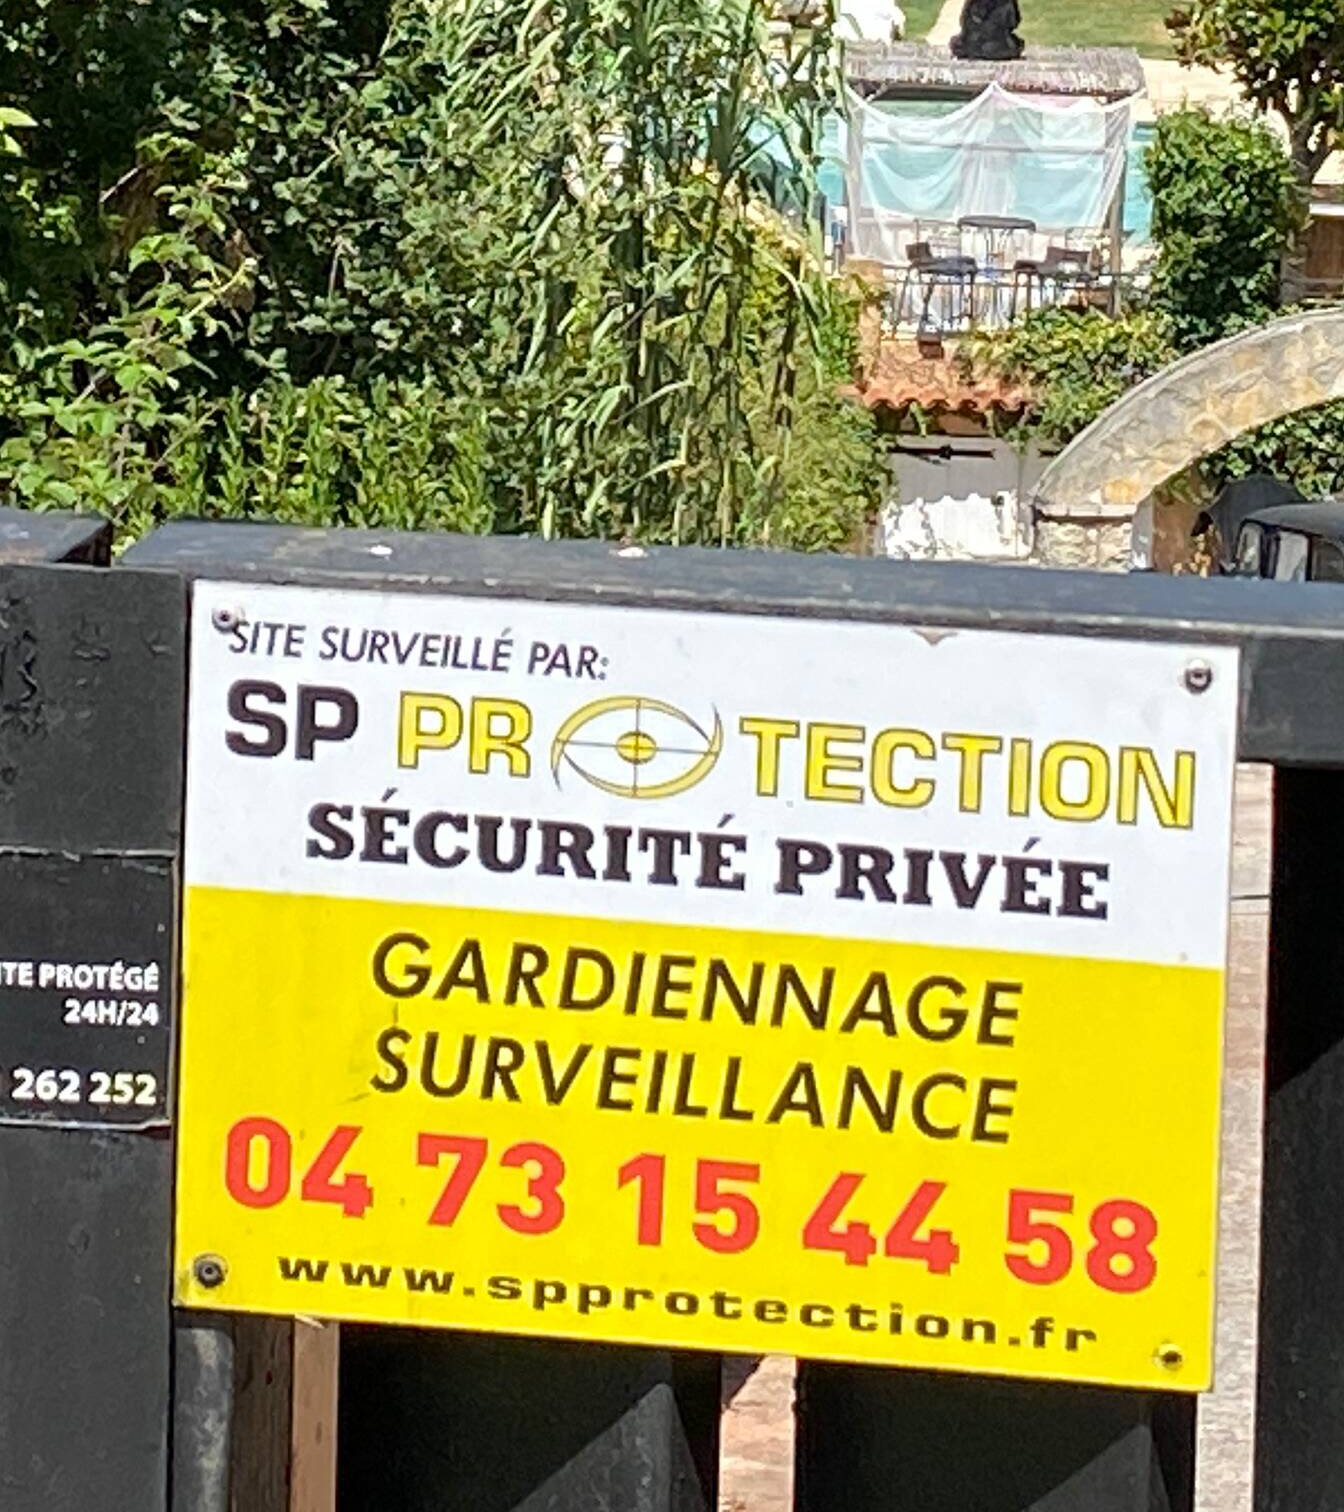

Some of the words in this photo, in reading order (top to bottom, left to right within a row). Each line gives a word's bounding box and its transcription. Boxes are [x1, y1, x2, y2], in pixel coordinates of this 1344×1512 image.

[229, 619, 307, 658] SITE
[319, 627, 514, 674] SURVEILLÉ
[527, 640, 610, 681] PAR:
[224, 678, 359, 763] SP
[305, 787, 748, 892] SÉCURITÉ
[773, 836, 1111, 921] PRIVÉE
[38, 959, 159, 992] PROTÉGÉ
[63, 998, 159, 1027] 24H/24
[370, 931, 1025, 1048] GARDIENNAGE
[11, 1069, 81, 1102] 262
[88, 1072, 157, 1106] 252
[370, 1024, 1021, 1146] SURVEILLANCE
[223, 1115, 374, 1220] 04
[414, 1132, 567, 1236] 73
[616, 1152, 762, 1255] 15
[802, 1171, 961, 1276] 44
[1003, 1188, 1160, 1294] 58
[277, 1255, 1098, 1353] www.spprotection.fr
